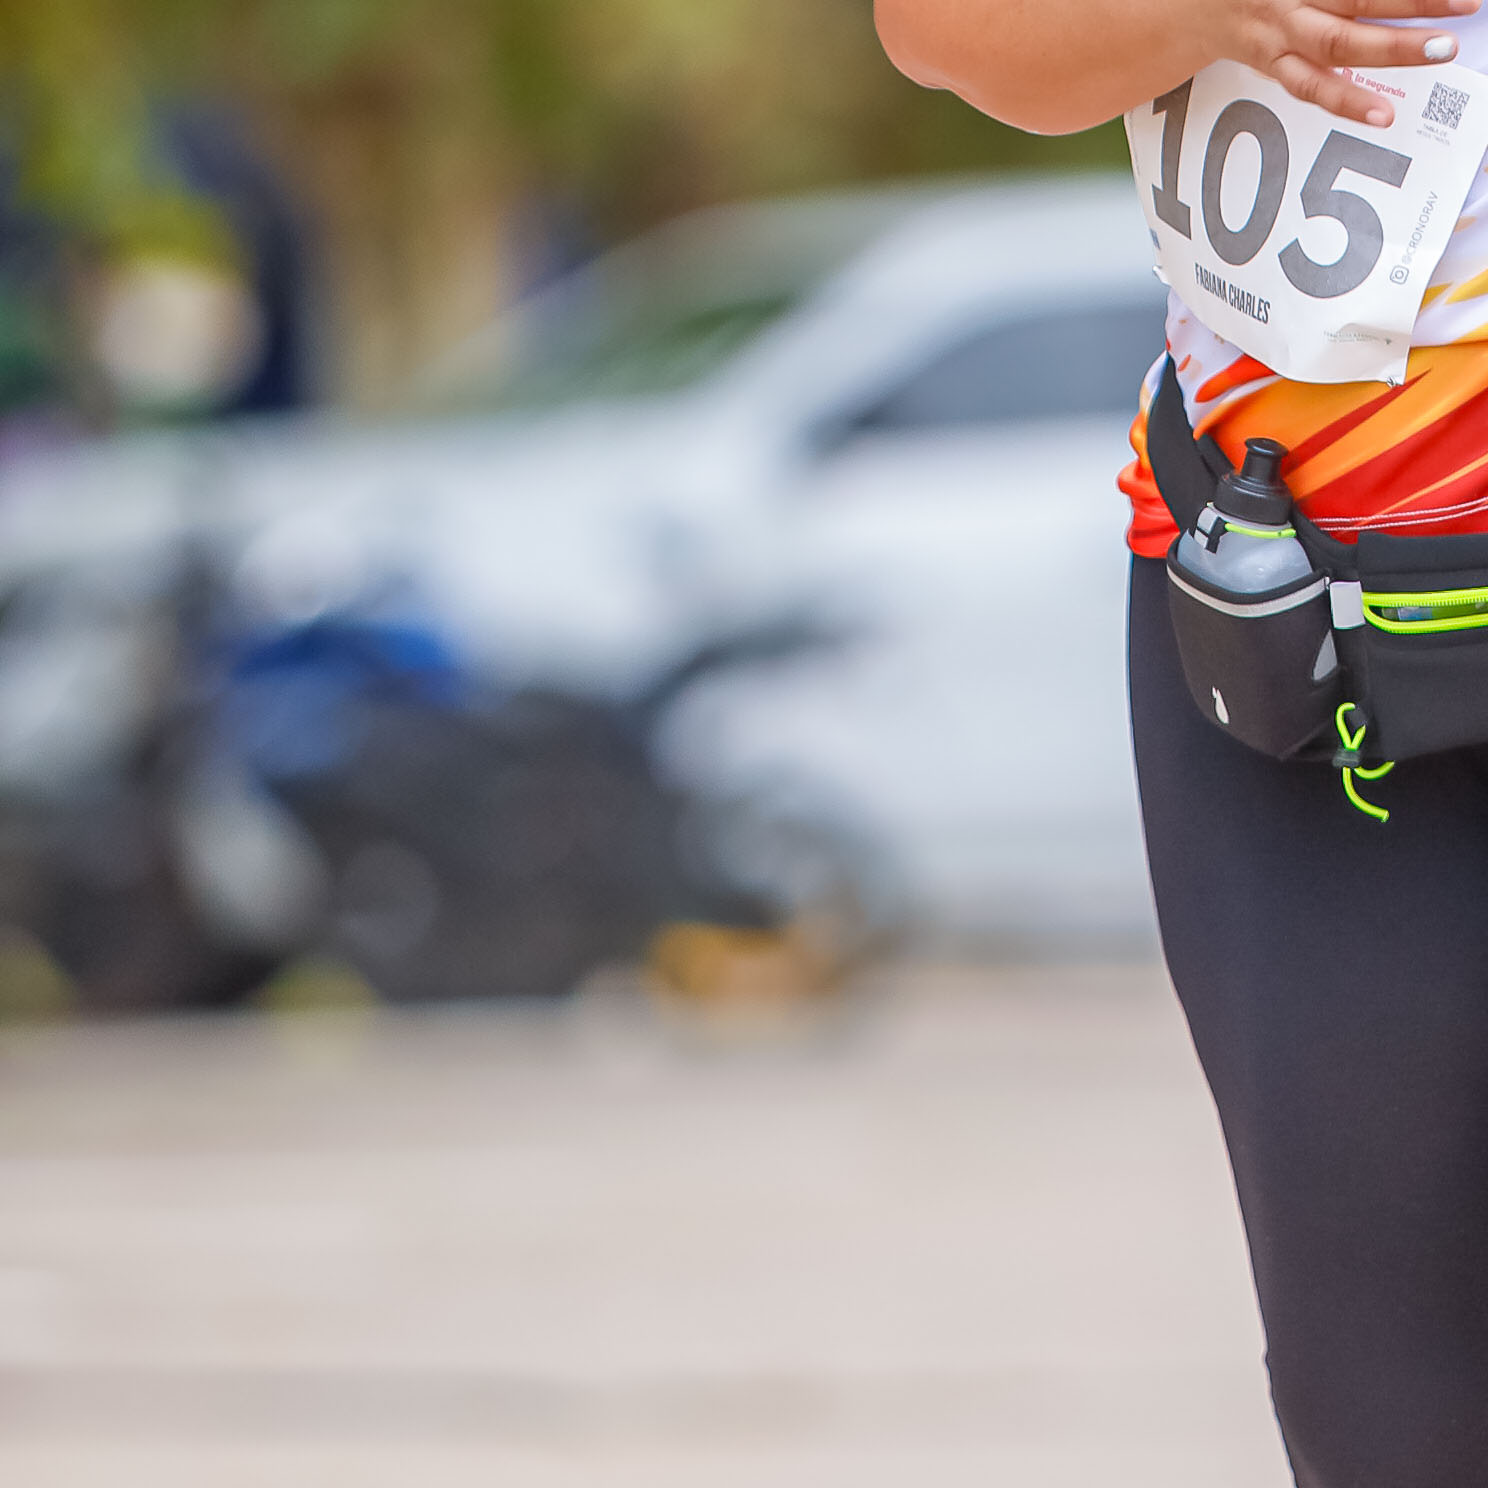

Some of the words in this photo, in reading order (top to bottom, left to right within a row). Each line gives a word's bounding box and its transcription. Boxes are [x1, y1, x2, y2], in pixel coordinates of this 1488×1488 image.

[1354, 73, 1364, 84] la
[1366, 79, 1406, 99] segunda
[1152, 76, 1412, 299] 105
[1195, 262, 1228, 303] FABIANA
[1229, 283, 1271, 324] CHARLES
